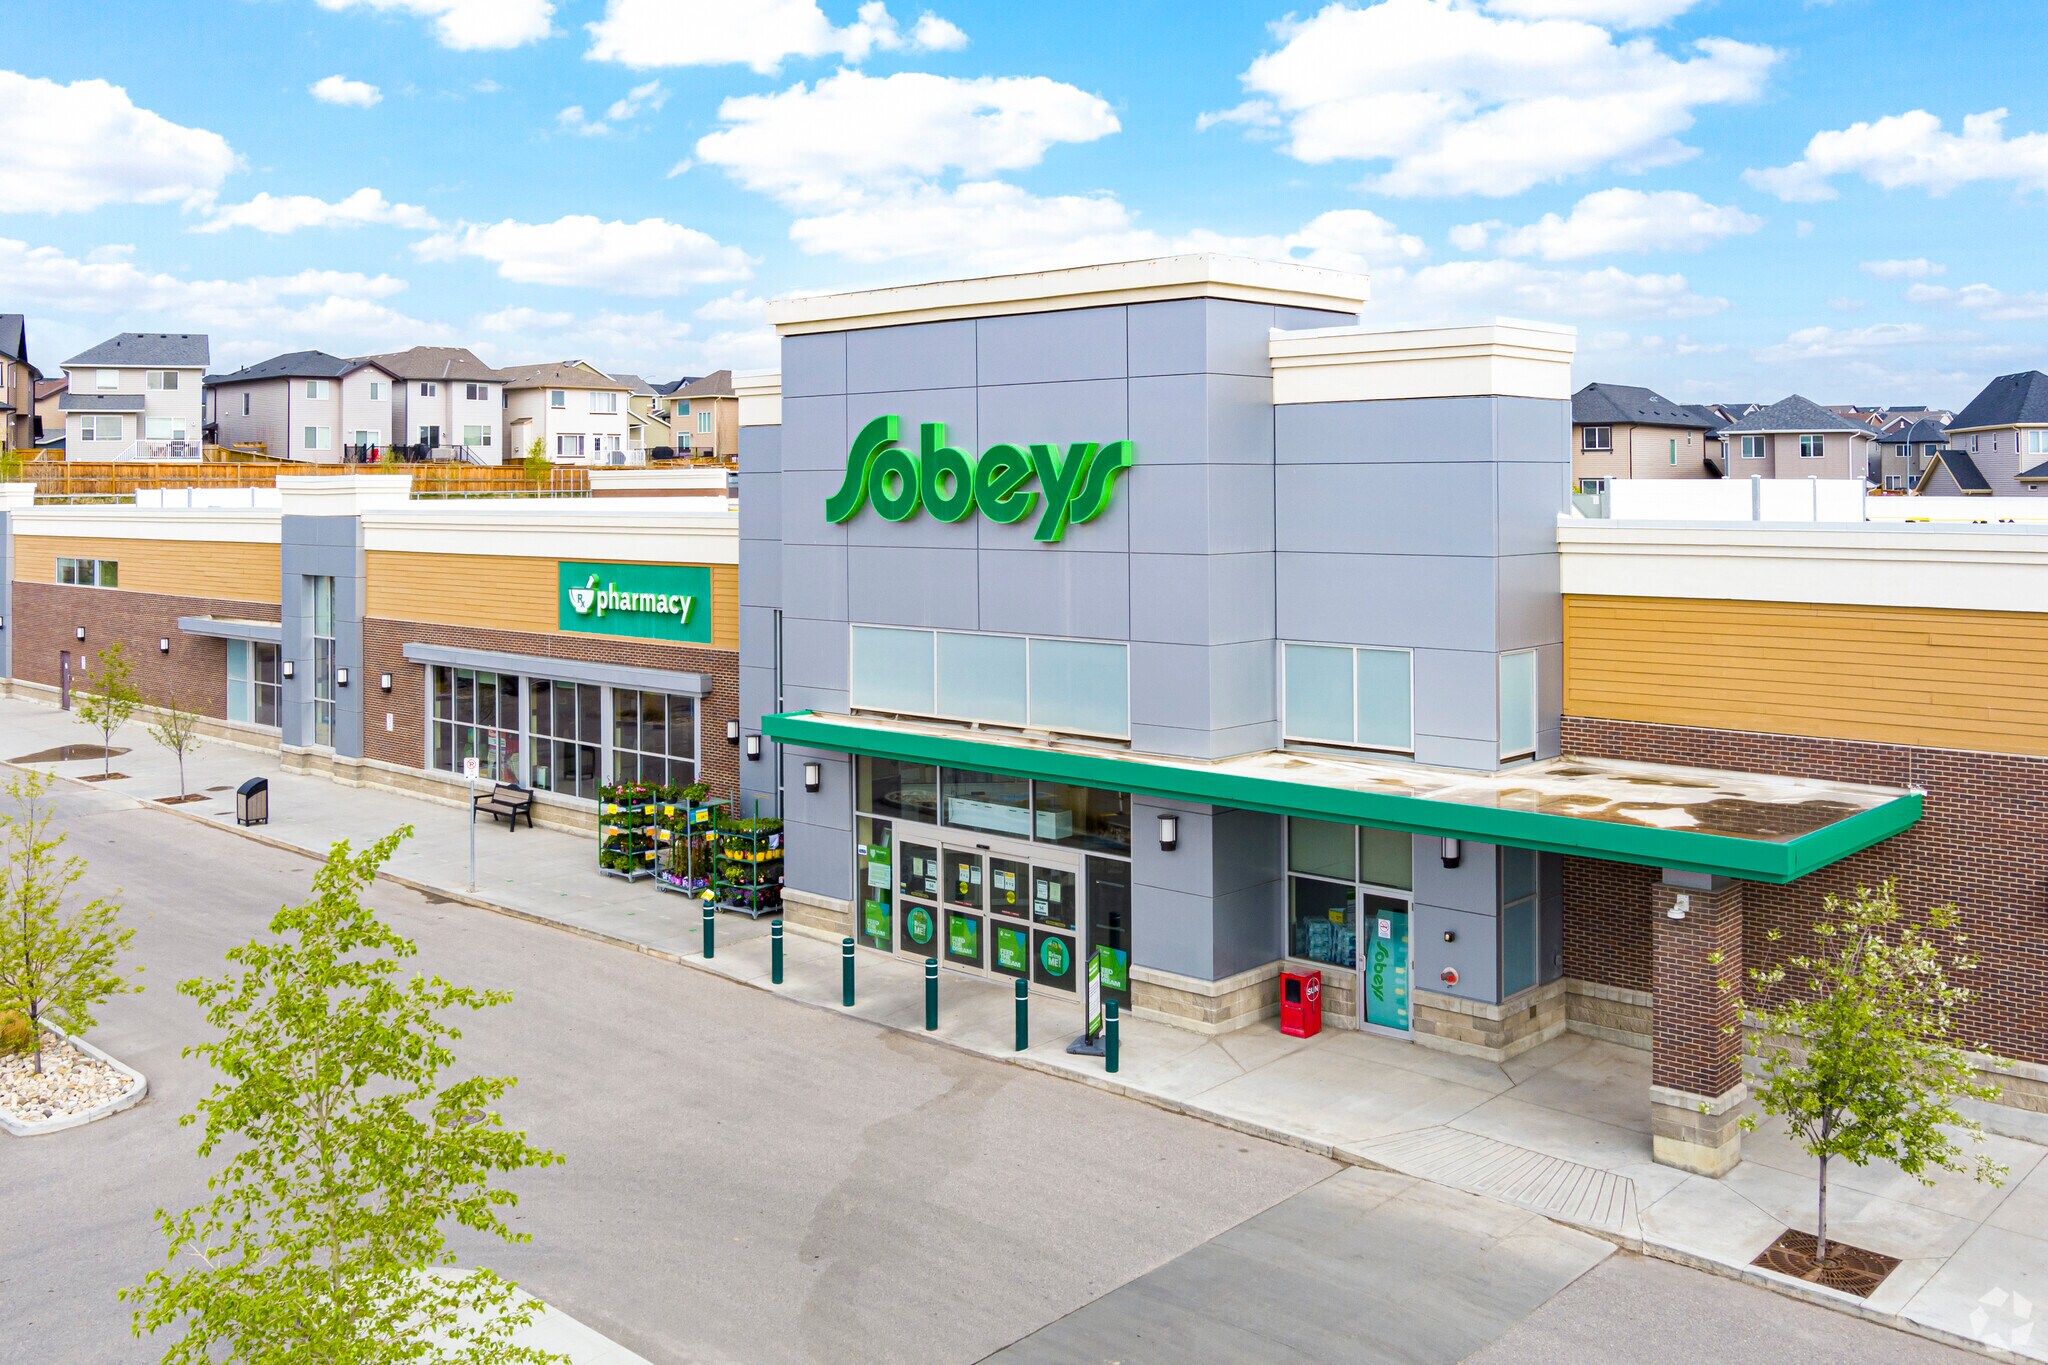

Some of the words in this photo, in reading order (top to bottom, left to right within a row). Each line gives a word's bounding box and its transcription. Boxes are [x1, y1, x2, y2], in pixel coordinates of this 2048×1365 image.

[826, 414, 1132, 541] Sobeys
[597, 582, 695, 624] pharmacy
[914, 926, 926, 936] ME!
[1000, 948, 1013, 956] FEED
[1048, 951, 1061, 960] Bring
[1000, 959, 1021, 968] DREAM
[1048, 958, 1061, 968] ME!
[1371, 941, 1389, 1002] Sobeys
[1307, 985, 1319, 995] SUN
